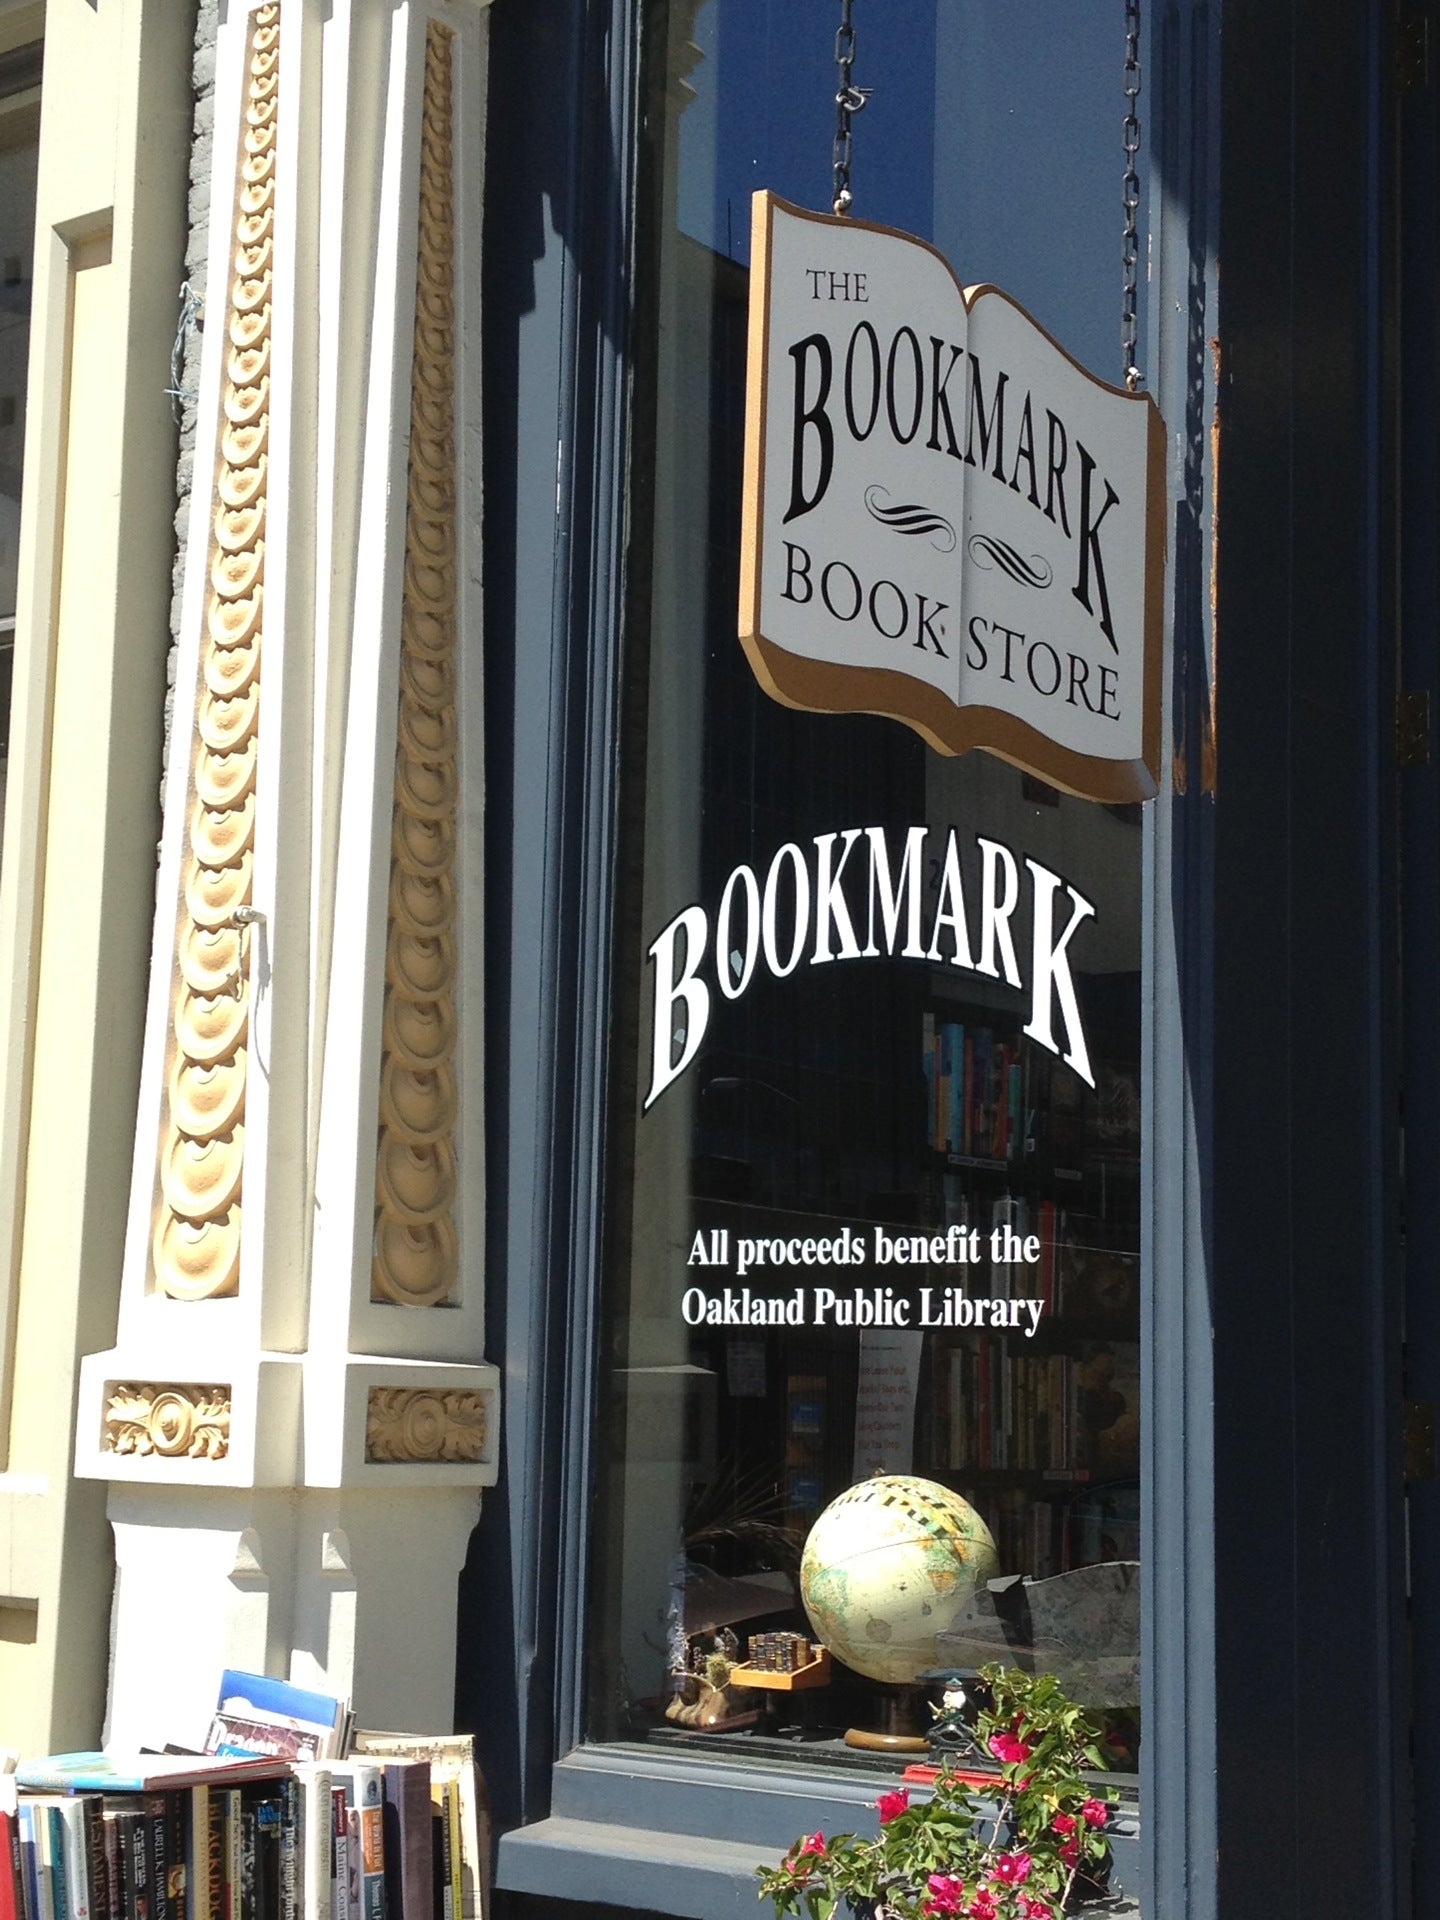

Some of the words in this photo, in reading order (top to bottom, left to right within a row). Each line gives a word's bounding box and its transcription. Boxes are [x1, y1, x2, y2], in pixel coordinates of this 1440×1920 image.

[805, 268, 870, 303] THE
[782, 320, 1121, 656] BOOKMARK
[780, 540, 949, 660] BOOK
[965, 614, 1122, 722] STORE
[642, 826, 1097, 1114] BOOKMARK
[686, 1229, 729, 1266] All
[737, 1227, 865, 1275] proceeds
[874, 1224, 981, 1264] benefit
[989, 1224, 1041, 1264] the
[681, 1288, 804, 1326] Oakland
[813, 1288, 911, 1326] Public
[918, 1288, 1045, 1337] Library
[338, 1842, 347, 1881] Maine
